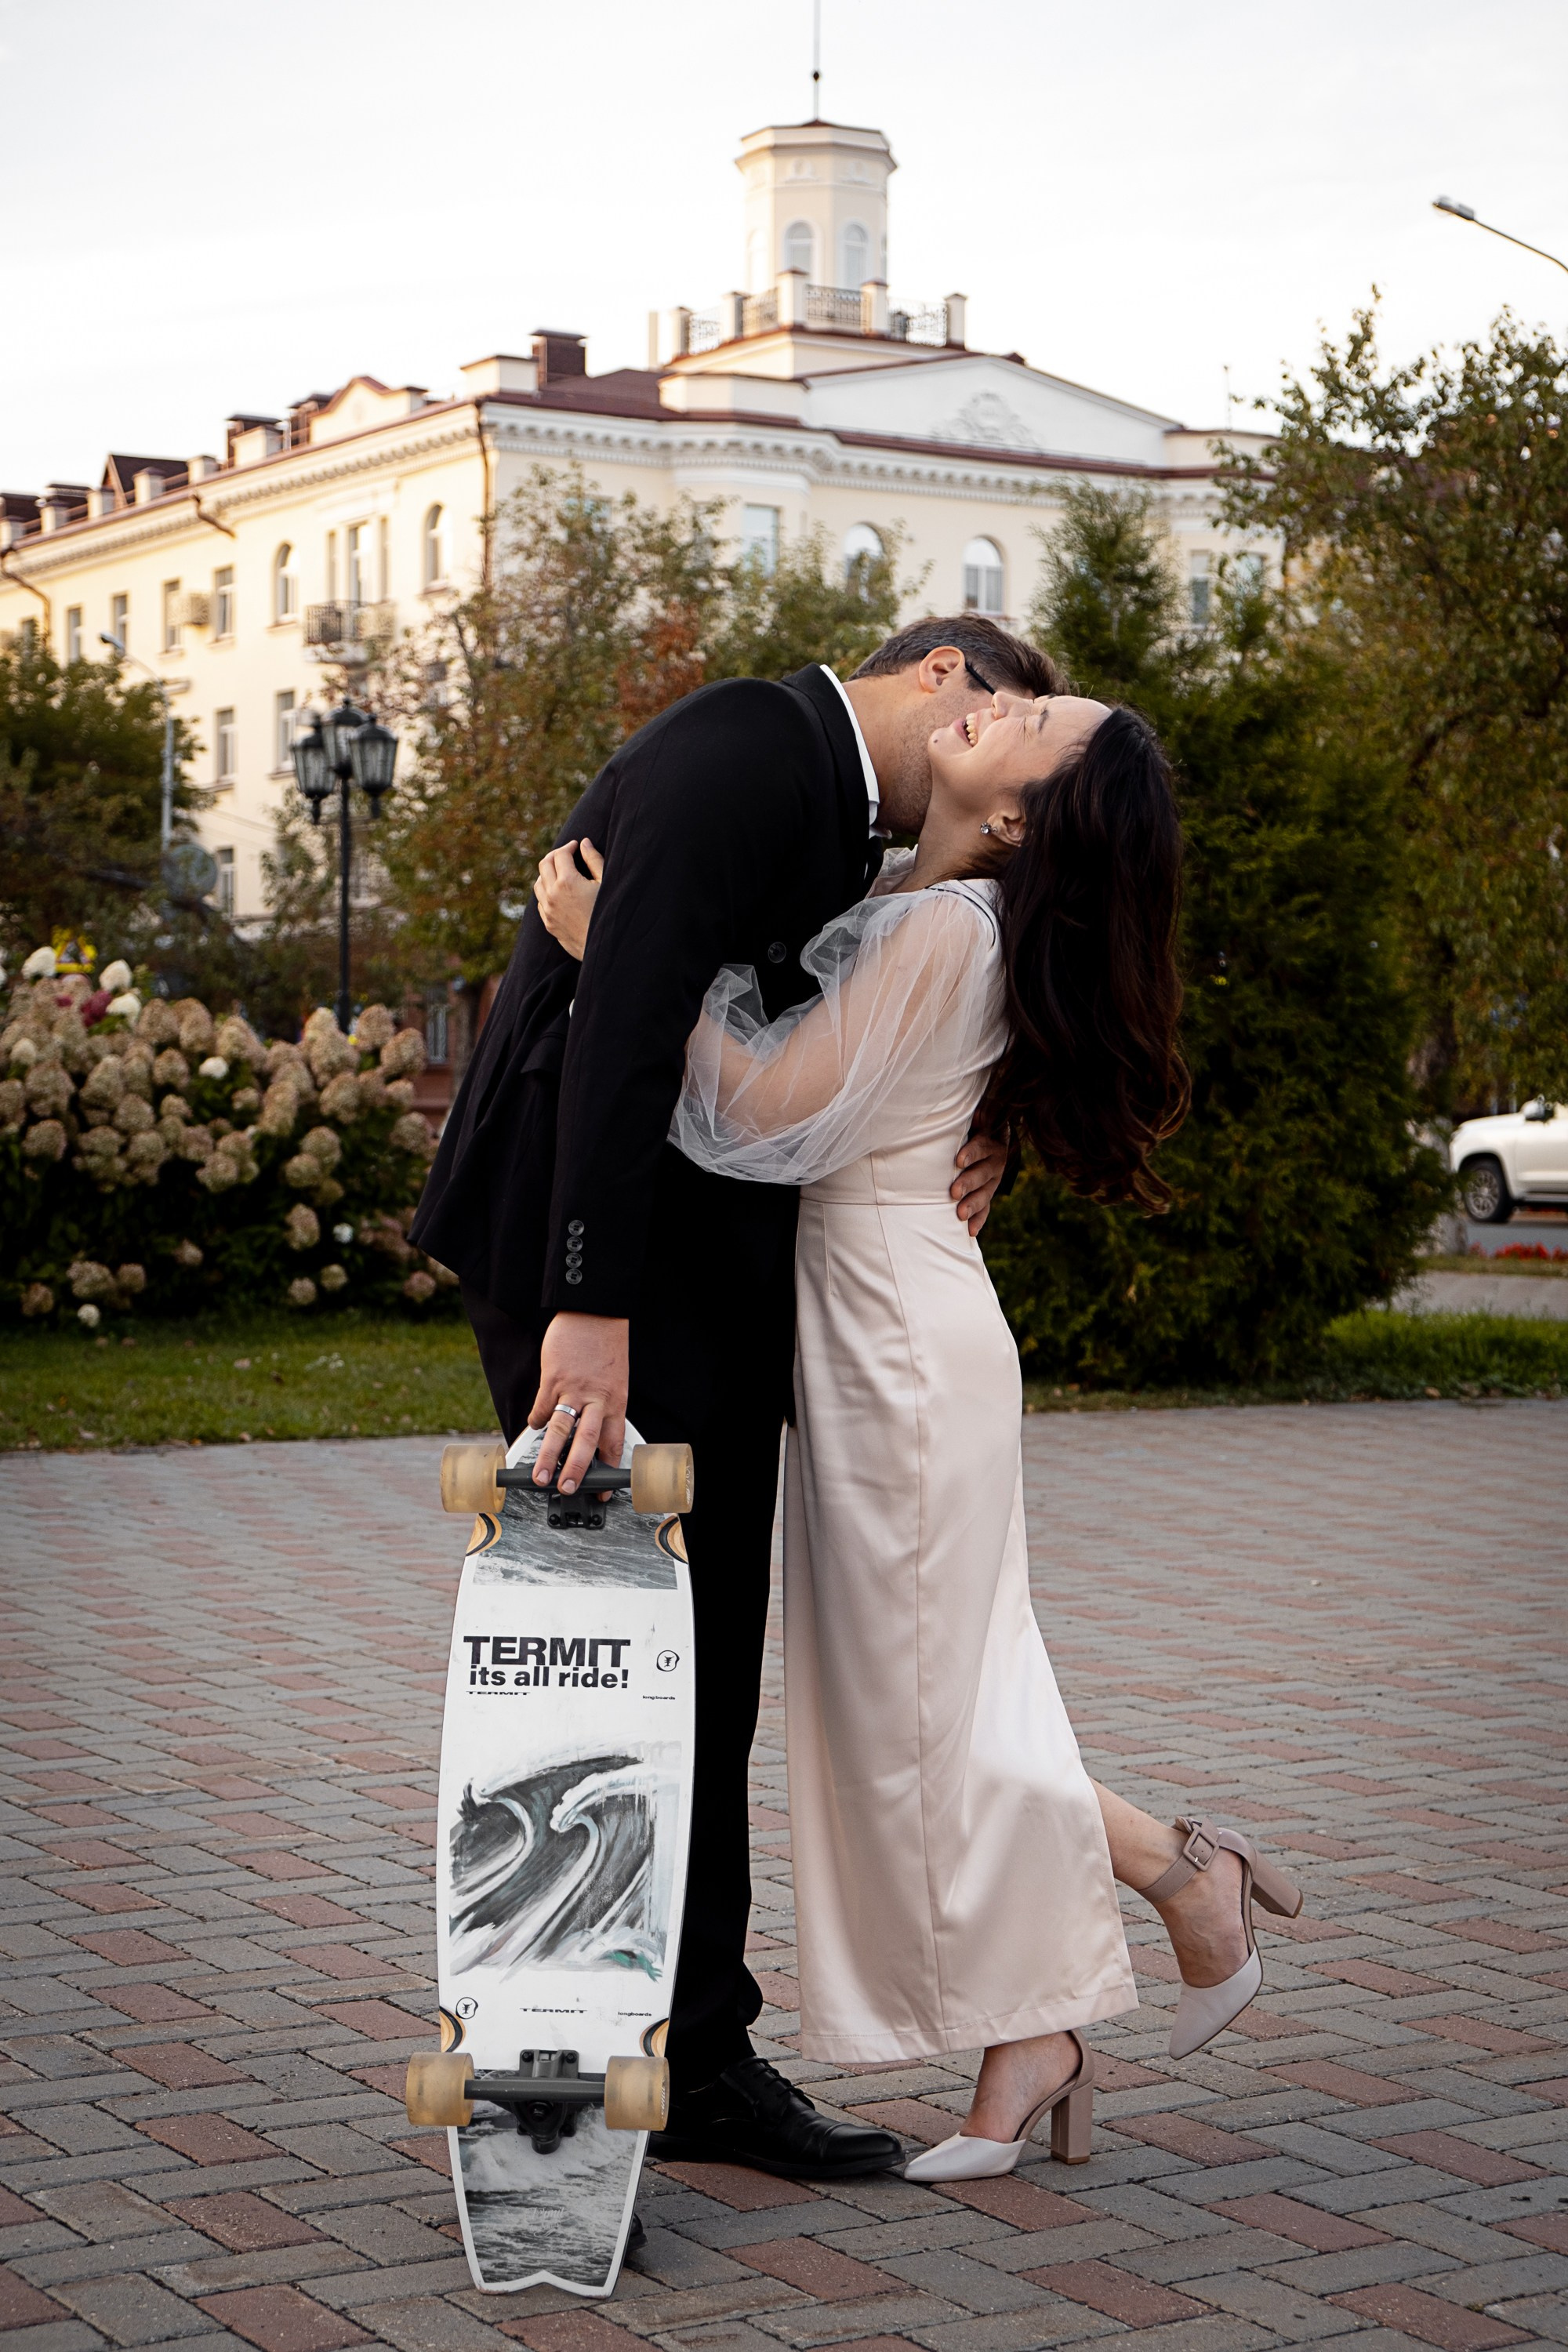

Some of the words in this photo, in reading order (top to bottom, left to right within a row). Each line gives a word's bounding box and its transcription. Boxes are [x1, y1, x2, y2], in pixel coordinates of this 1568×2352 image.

[463, 1635, 630, 1668] TERMIT
[470, 1664, 506, 1686] its
[514, 1666, 549, 1686] all
[559, 1667, 628, 1688] ride!
